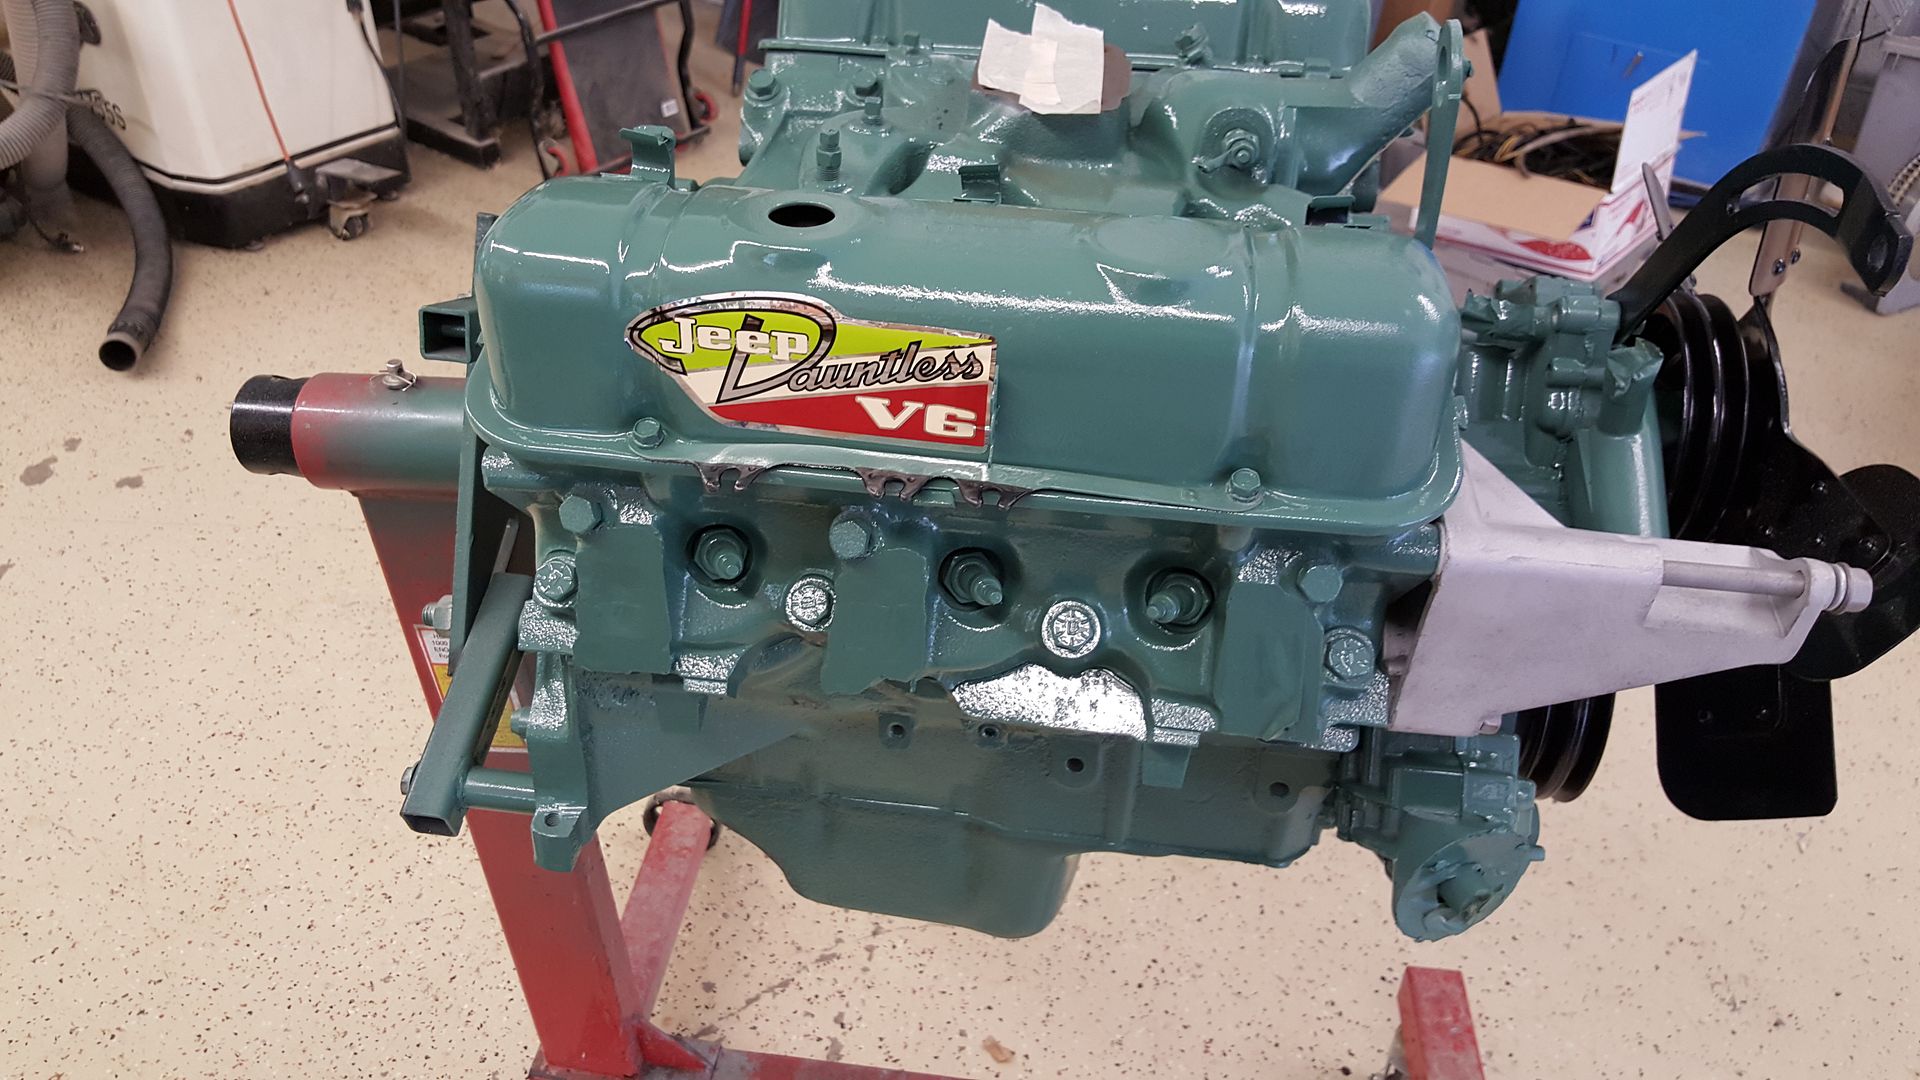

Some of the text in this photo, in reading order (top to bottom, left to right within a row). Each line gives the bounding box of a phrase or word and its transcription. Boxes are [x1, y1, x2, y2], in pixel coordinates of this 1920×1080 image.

[658, 317, 808, 361] Jeep
[716, 298, 984, 404] Dauntless
[854, 395, 977, 438] V6
